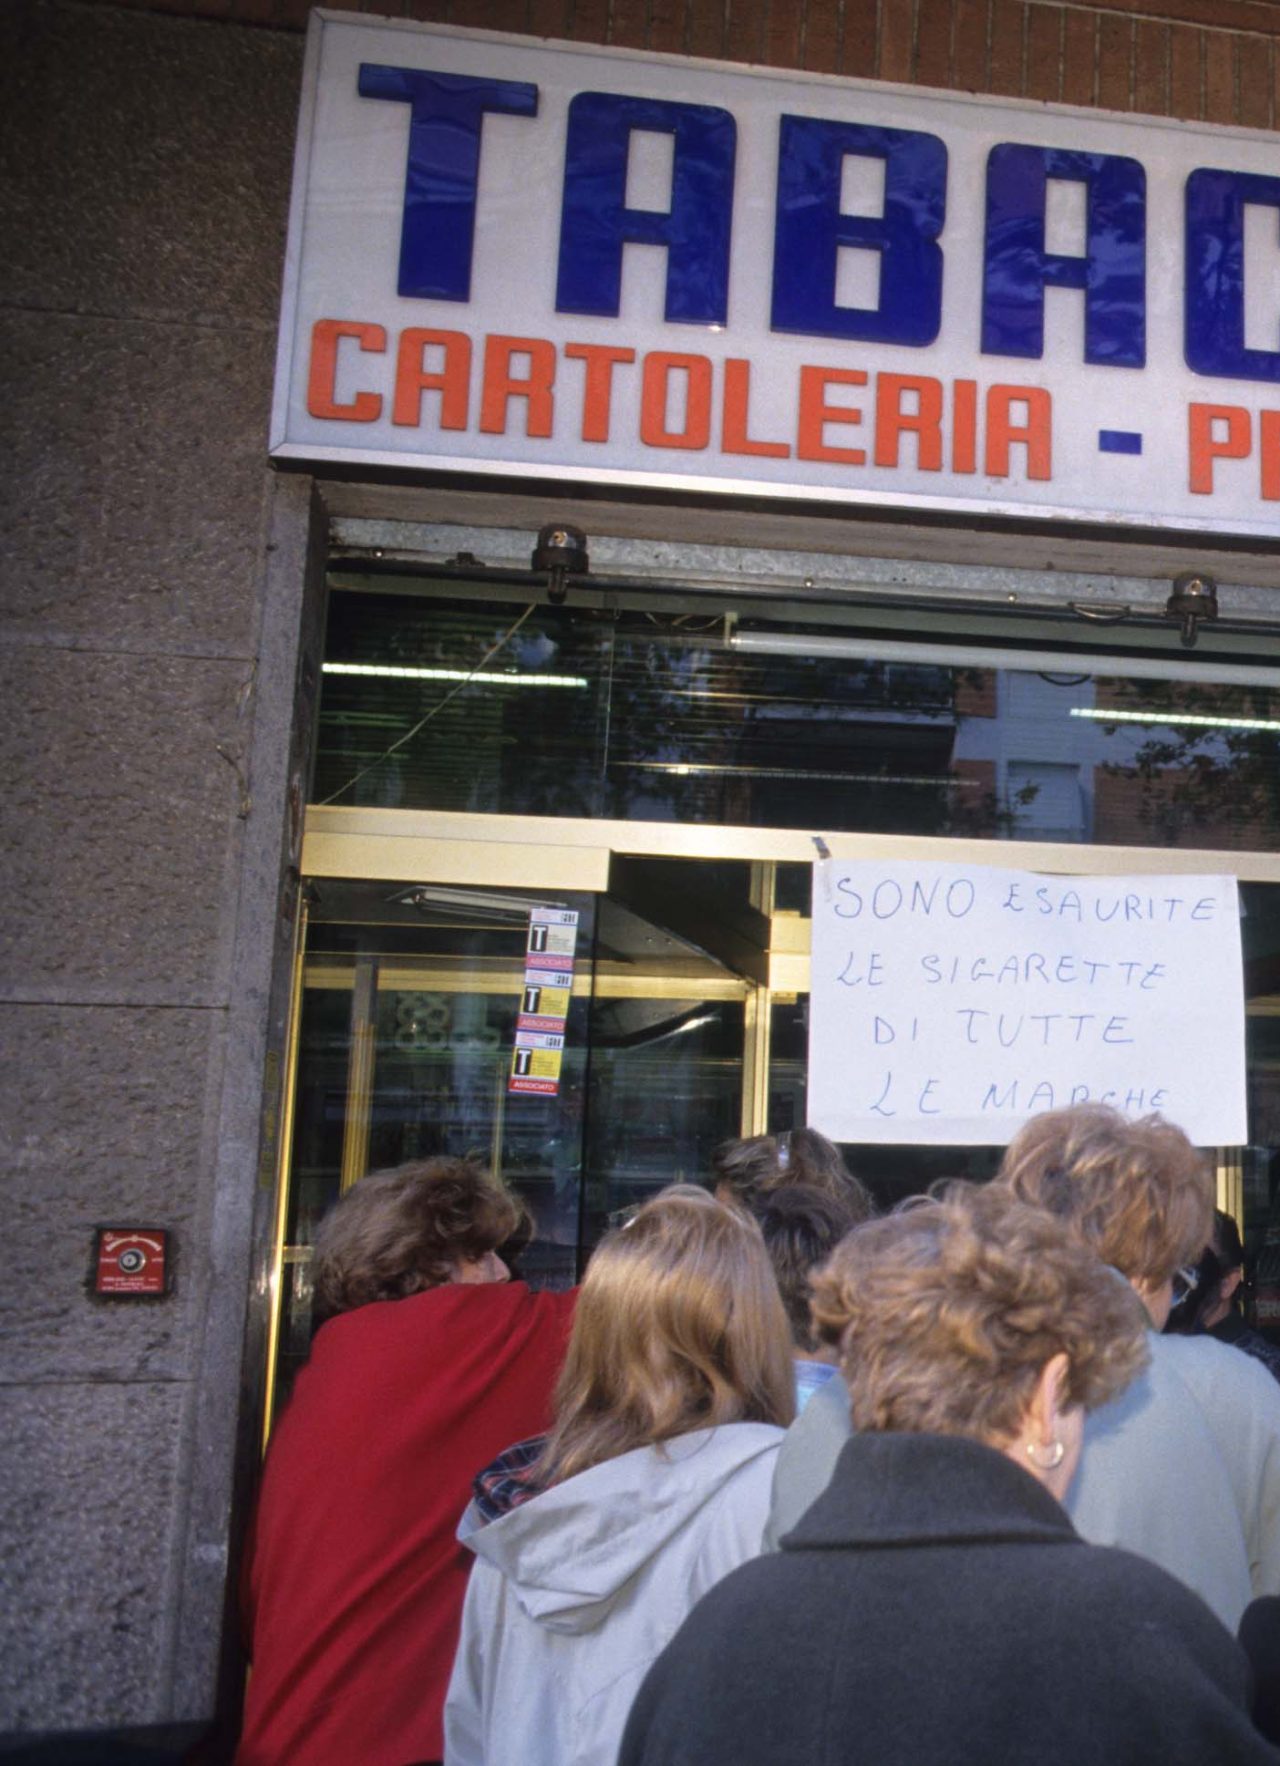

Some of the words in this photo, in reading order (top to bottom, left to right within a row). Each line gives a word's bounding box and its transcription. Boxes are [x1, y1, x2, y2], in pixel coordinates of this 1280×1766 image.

[306, 318, 1052, 482] CARTOLERIA
[834, 877, 976, 919] SONO
[1002, 883, 1217, 923] ESAURITE
[837, 952, 884, 986] LE
[921, 953, 1168, 990] SIGARETTE
[874, 1015, 918, 1045] DI
[957, 1010, 1134, 1047] TUTTE
[513, 1080, 554, 1090] ASSOCIATO
[870, 1071, 941, 1116] LE
